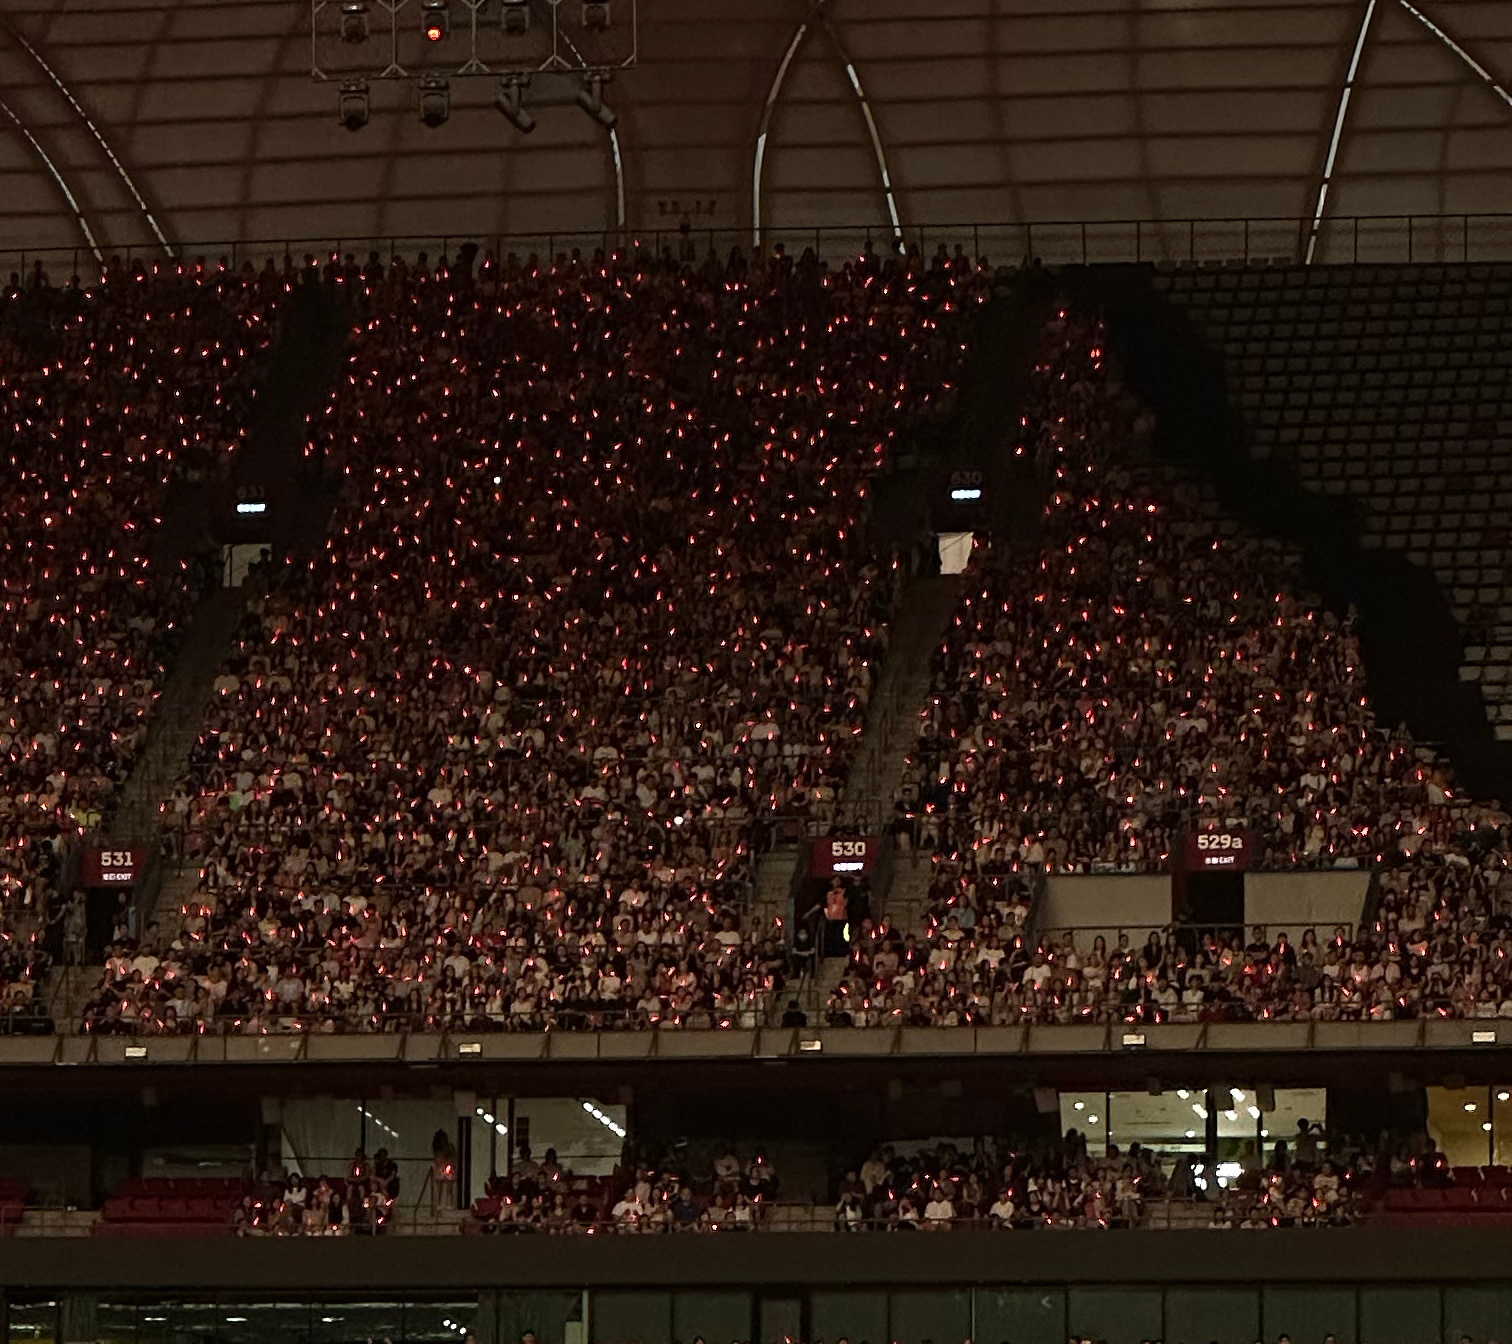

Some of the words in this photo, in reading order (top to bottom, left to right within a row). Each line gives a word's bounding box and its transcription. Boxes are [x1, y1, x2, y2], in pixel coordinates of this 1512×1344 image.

[831, 841, 866, 856] 530
[1197, 834, 1243, 850] 529a
[101, 851, 134, 866] 531
